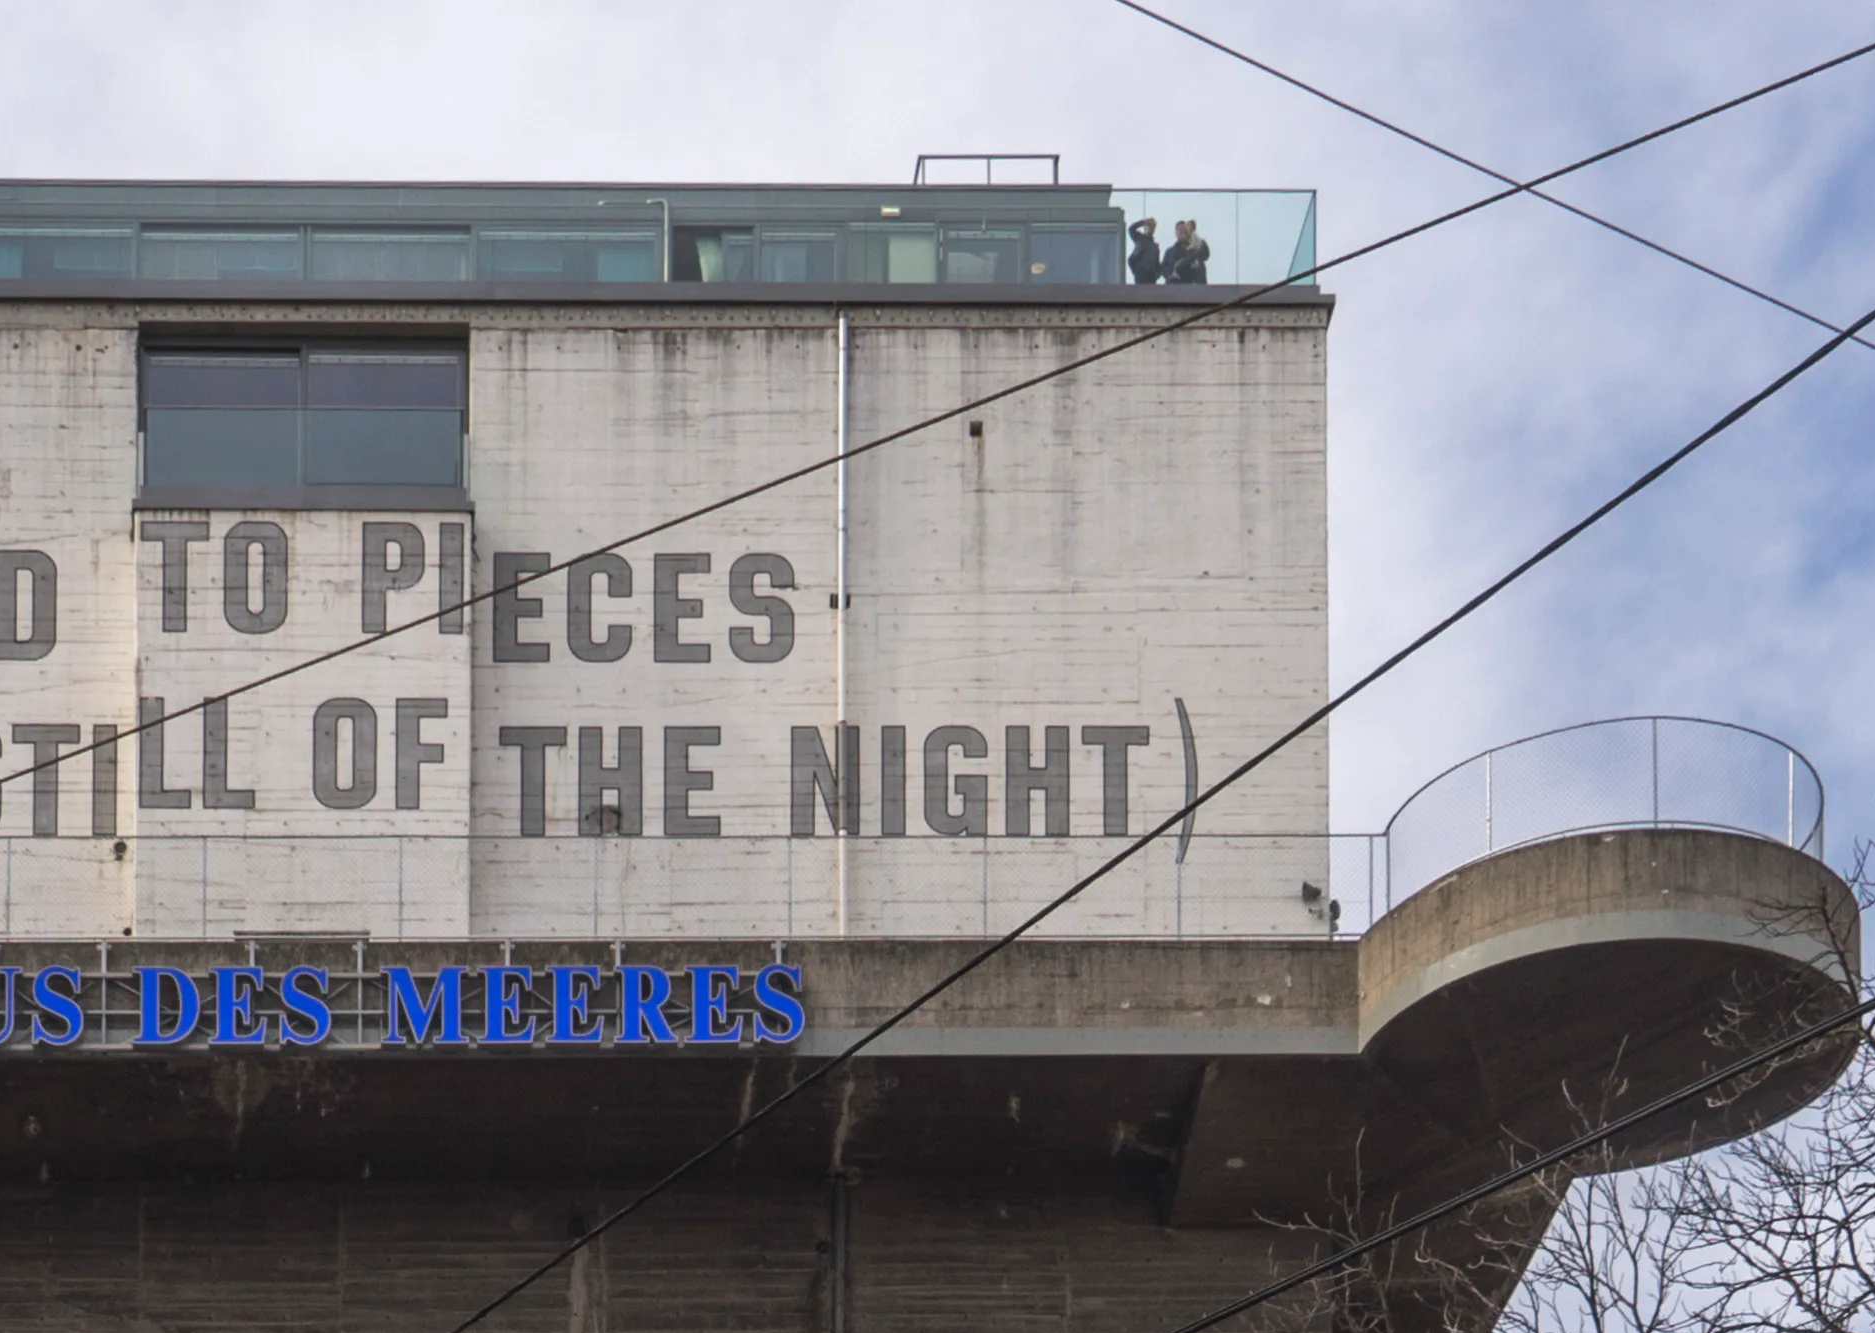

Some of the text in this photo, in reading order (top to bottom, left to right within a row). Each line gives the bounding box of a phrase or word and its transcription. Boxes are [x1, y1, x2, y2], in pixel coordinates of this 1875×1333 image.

[139, 519, 290, 635] TO
[361, 520, 796, 664] PIECES
[311, 697, 449, 811] OF
[498, 724, 722, 838] THE
[790, 696, 1199, 866] NIGHT)
[133, 964, 331, 1047] DES
[380, 962, 806, 1046] MEERES
